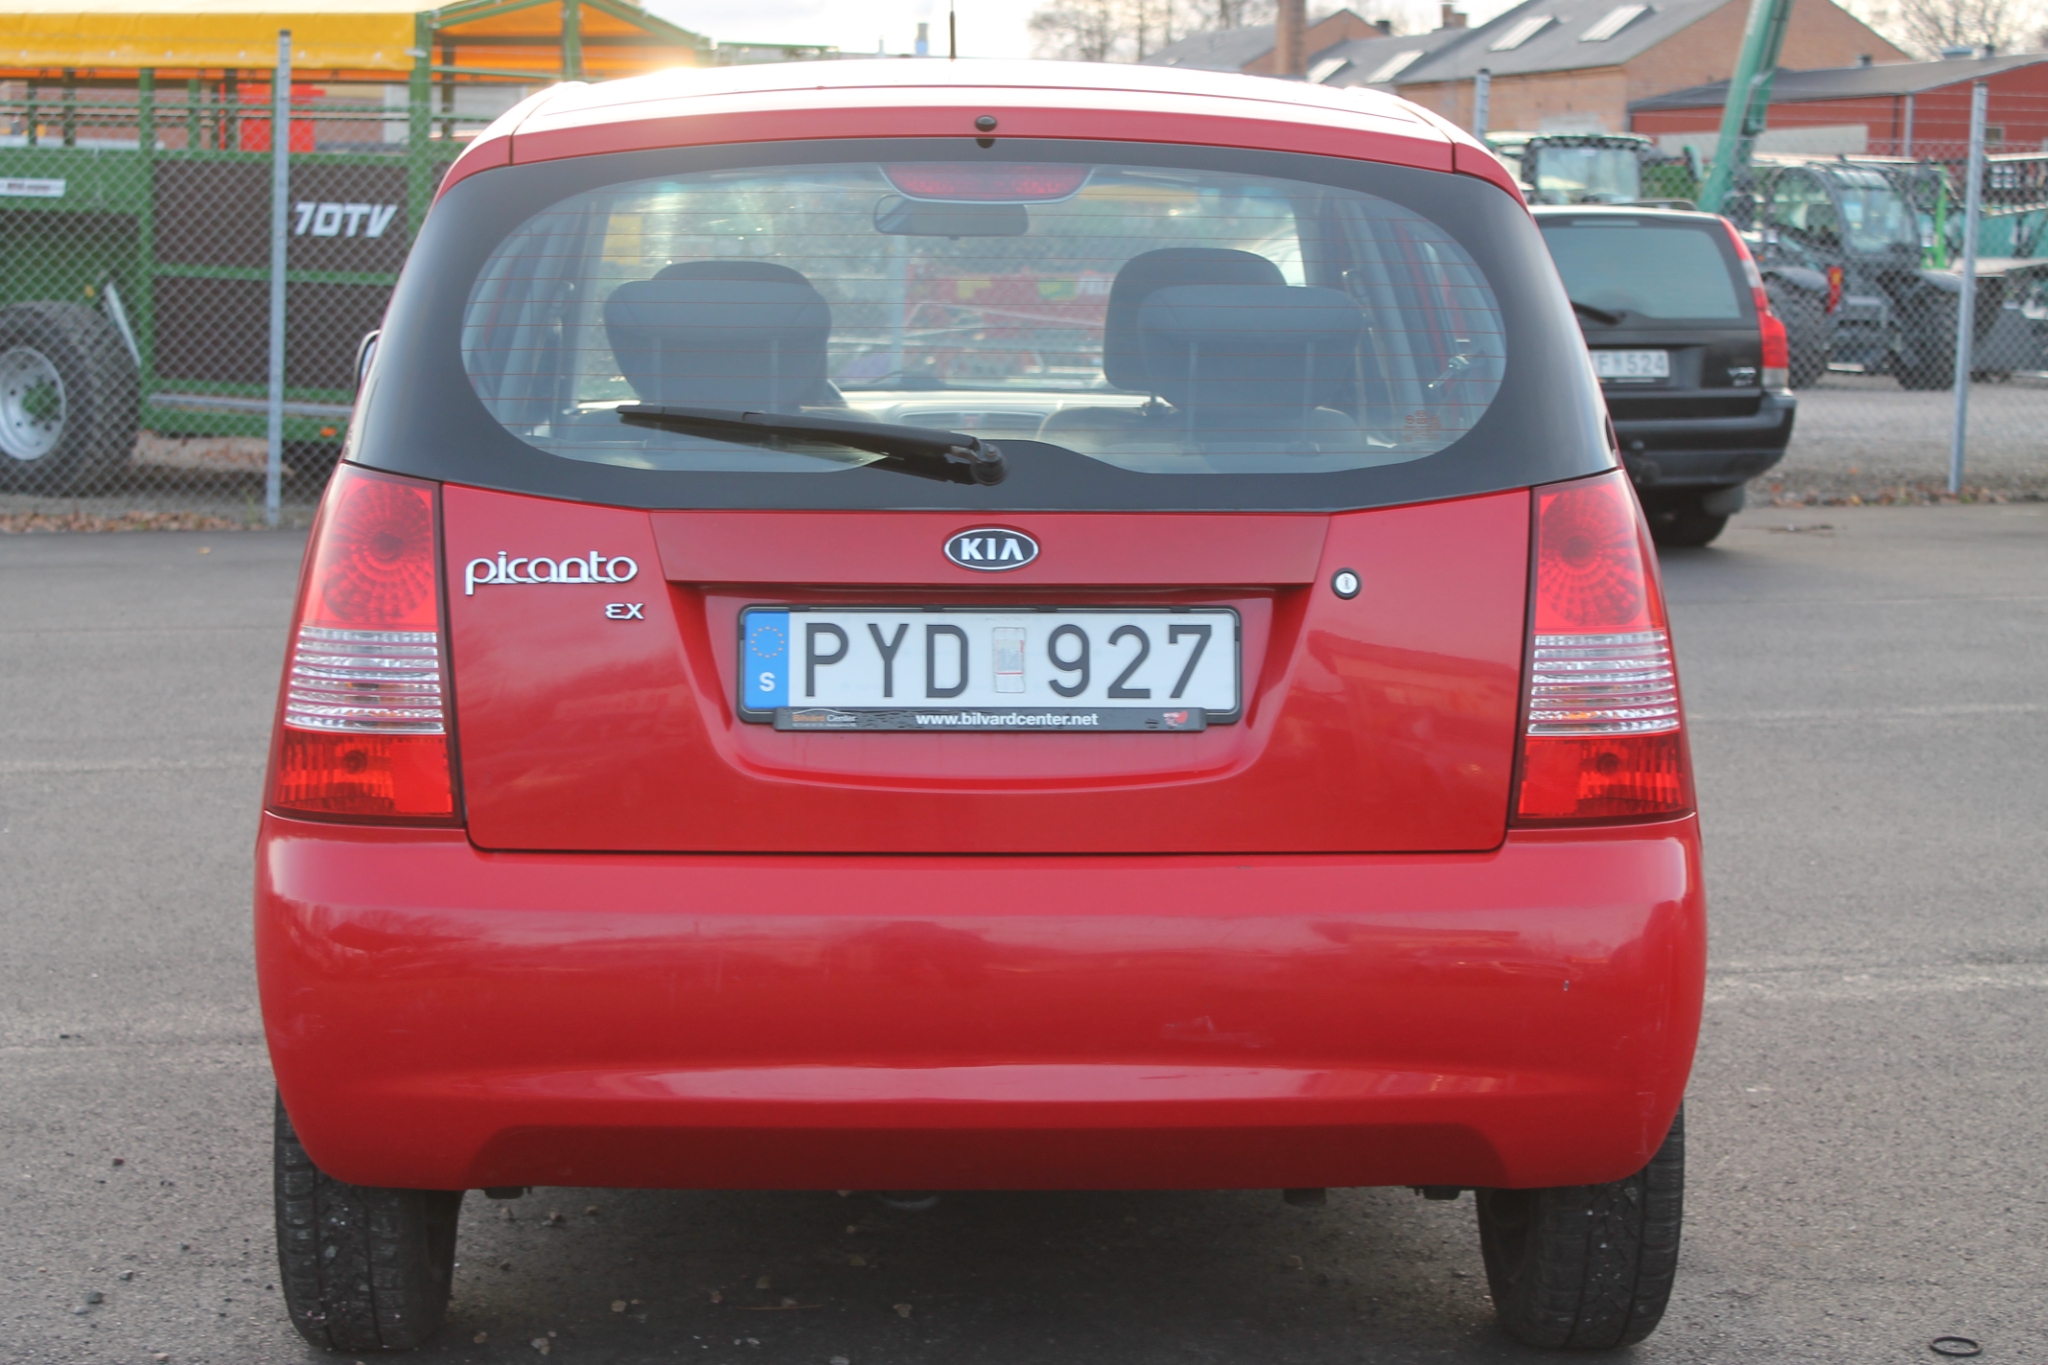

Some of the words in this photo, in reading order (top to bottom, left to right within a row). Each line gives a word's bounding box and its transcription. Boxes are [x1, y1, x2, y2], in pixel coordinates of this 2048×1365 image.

[1626, 354, 1665, 374] 524
[960, 538, 1024, 560] KIA
[465, 551, 639, 595] picanto
[605, 603, 644, 620] EX
[805, 622, 969, 698] PYD
[1048, 624, 1212, 699] 927
[759, 671, 776, 692] S
[915, 712, 1099, 726] www.bilvardcenter.net
